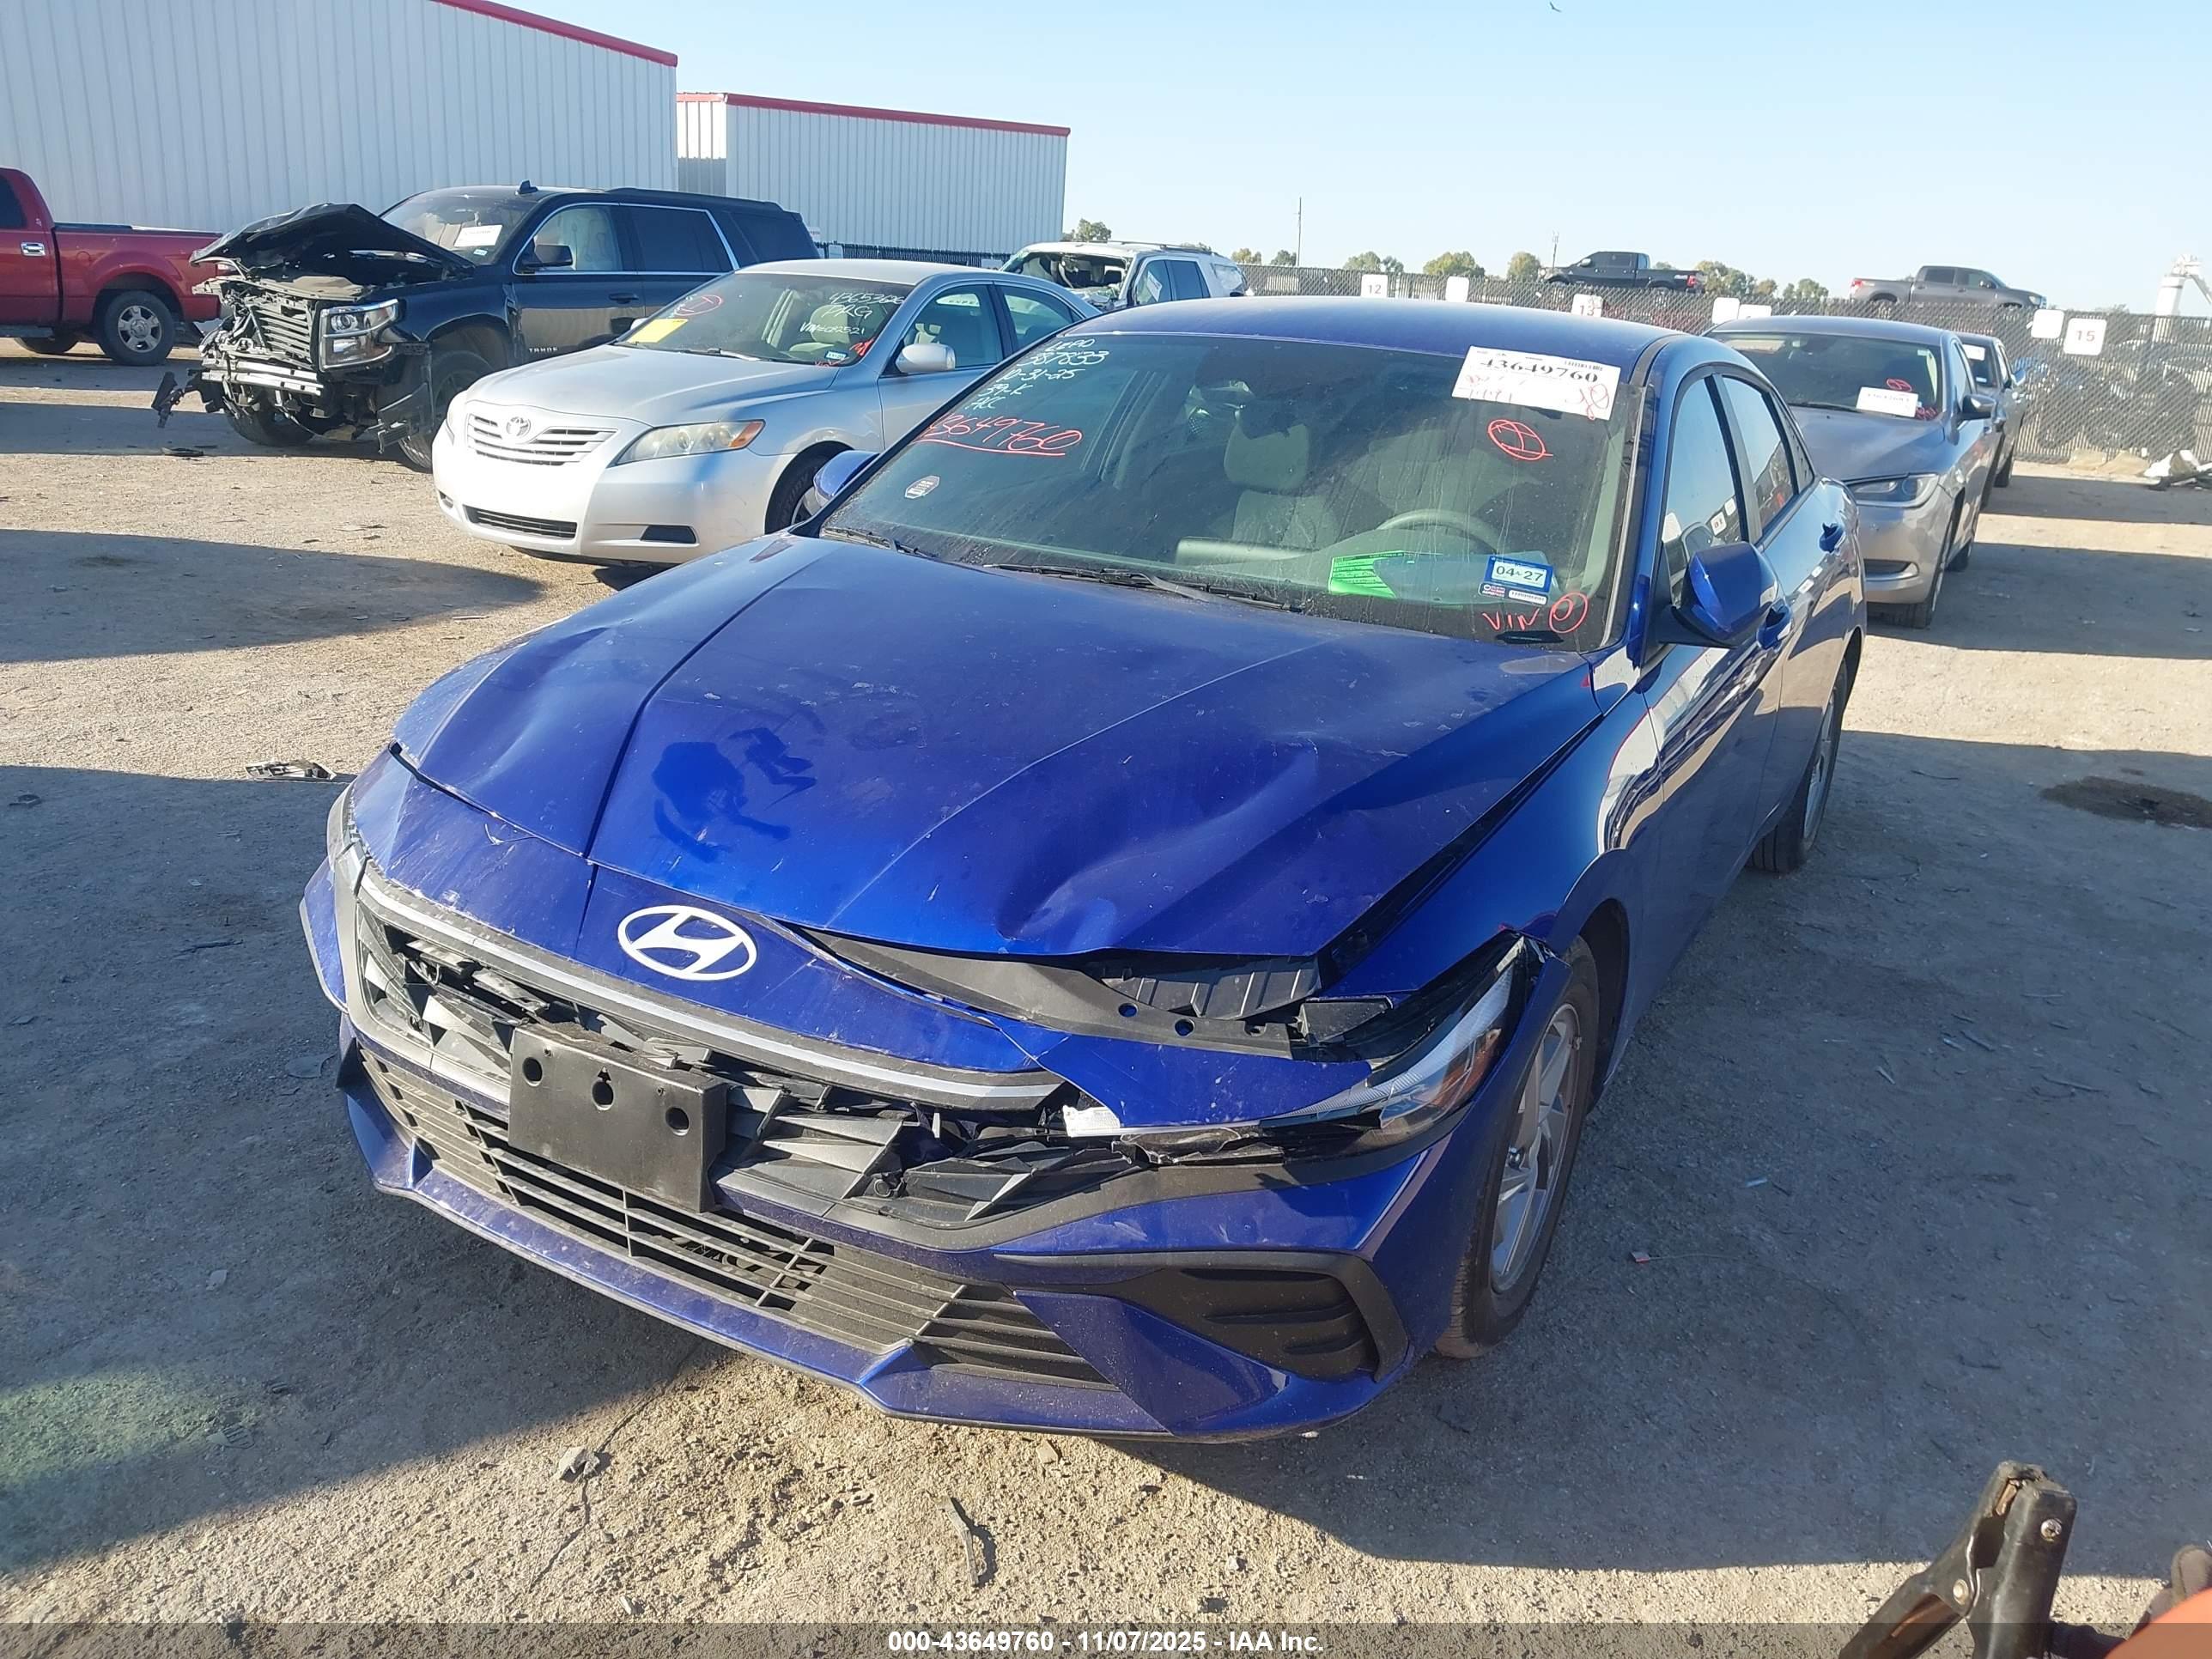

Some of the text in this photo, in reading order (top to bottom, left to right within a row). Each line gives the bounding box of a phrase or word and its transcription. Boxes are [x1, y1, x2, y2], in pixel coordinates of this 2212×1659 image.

[1368, 283, 1382, 295] 12
[2076, 330, 2096, 342] 15
[1480, 358, 1599, 384] 43649760
[1481, 607, 1540, 631] VIN
